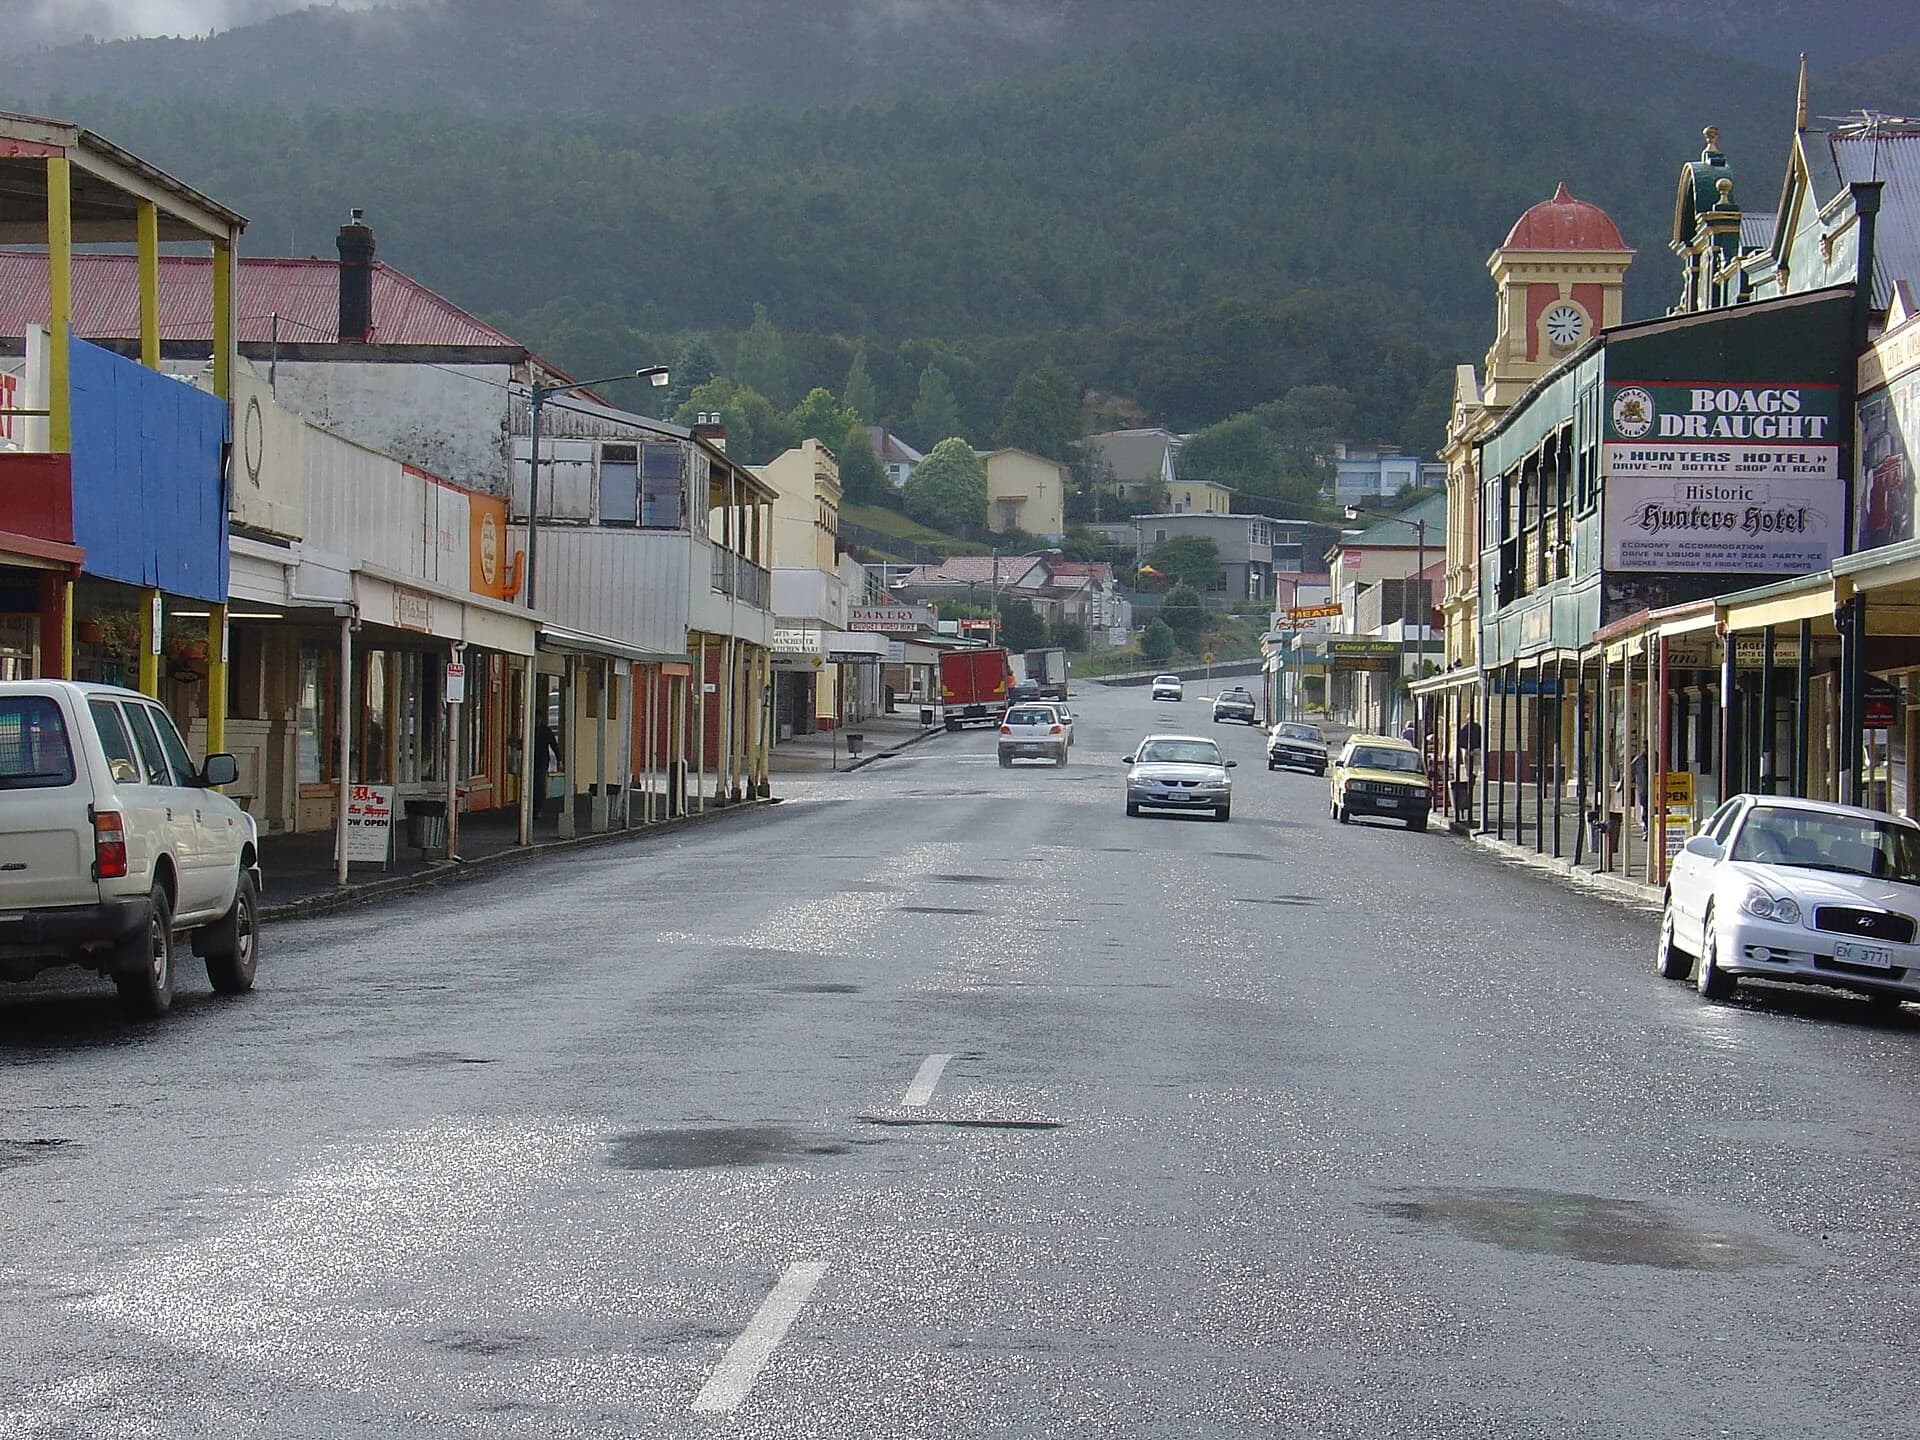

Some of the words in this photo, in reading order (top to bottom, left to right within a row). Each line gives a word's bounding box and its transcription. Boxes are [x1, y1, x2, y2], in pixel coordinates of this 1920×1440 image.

[1690, 389, 1801, 413] BOAGS
[1658, 414, 1828, 439] DRAUGHT
[1630, 452, 1731, 463] HUNTERS
[1743, 452, 1811, 464] HOTEL
[1612, 463, 1672, 471] DRIVE-IN
[1682, 463, 1728, 472] BOTTLE
[1735, 465, 1767, 473] SHOP
[1773, 465, 1786, 473] AT
[1793, 465, 1826, 473] REAR
[1686, 485, 1753, 501] Historic
[1639, 504, 1737, 536] Hunters
[1741, 506, 1807, 538] Hotel
[1678, 543, 1764, 551] ACCOMMODATION
[1666, 551, 1701, 559] LIQUOR
[853, 610, 912, 620] BAKERY
[1289, 608, 1339, 619] MEATS
[347, 818, 361, 826] OW
[364, 819, 388, 827] OPEN
[1860, 950, 1889, 964] 3771
